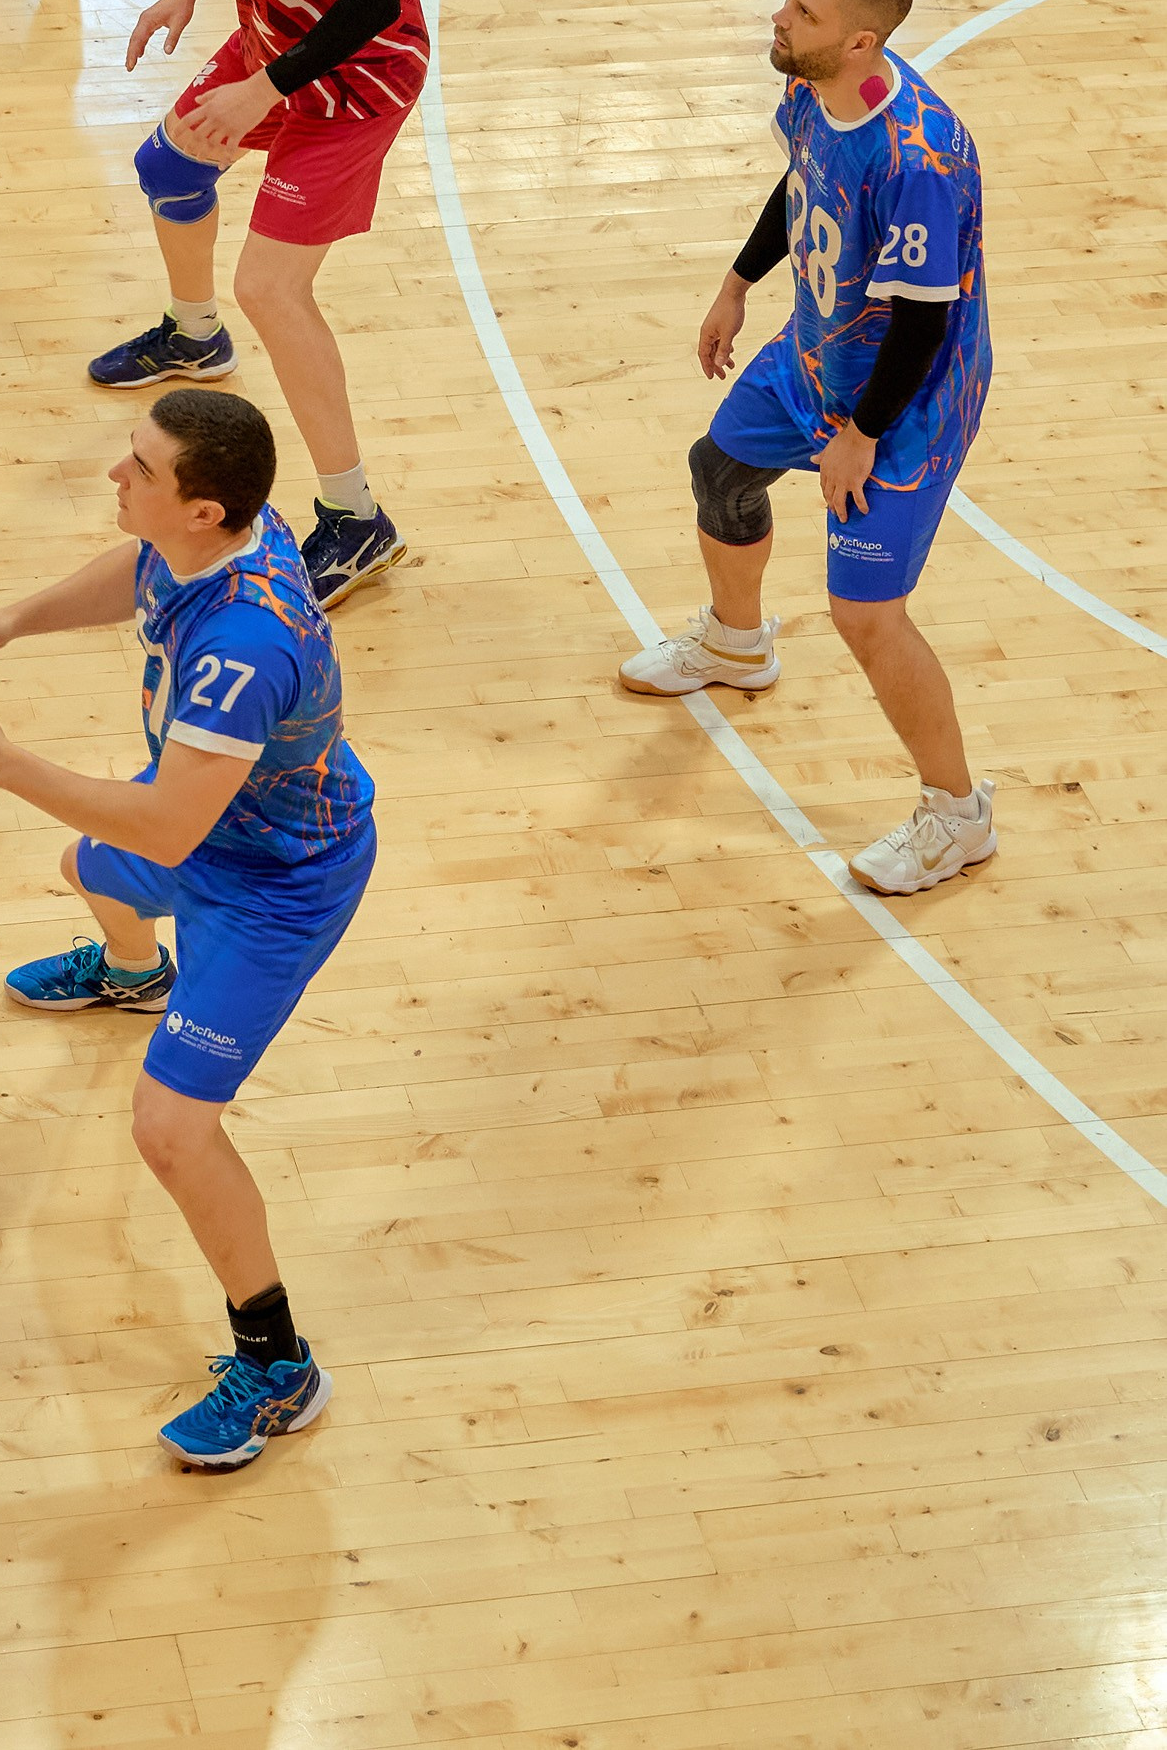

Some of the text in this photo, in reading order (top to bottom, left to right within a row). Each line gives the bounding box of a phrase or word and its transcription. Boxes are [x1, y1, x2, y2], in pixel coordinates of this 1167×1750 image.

[787, 170, 842, 318] 28
[878, 223, 928, 268] 28
[839, 535, 883, 551] РусГидро
[190, 654, 256, 714] 27
[185, 1019, 236, 1045] РусГидро
